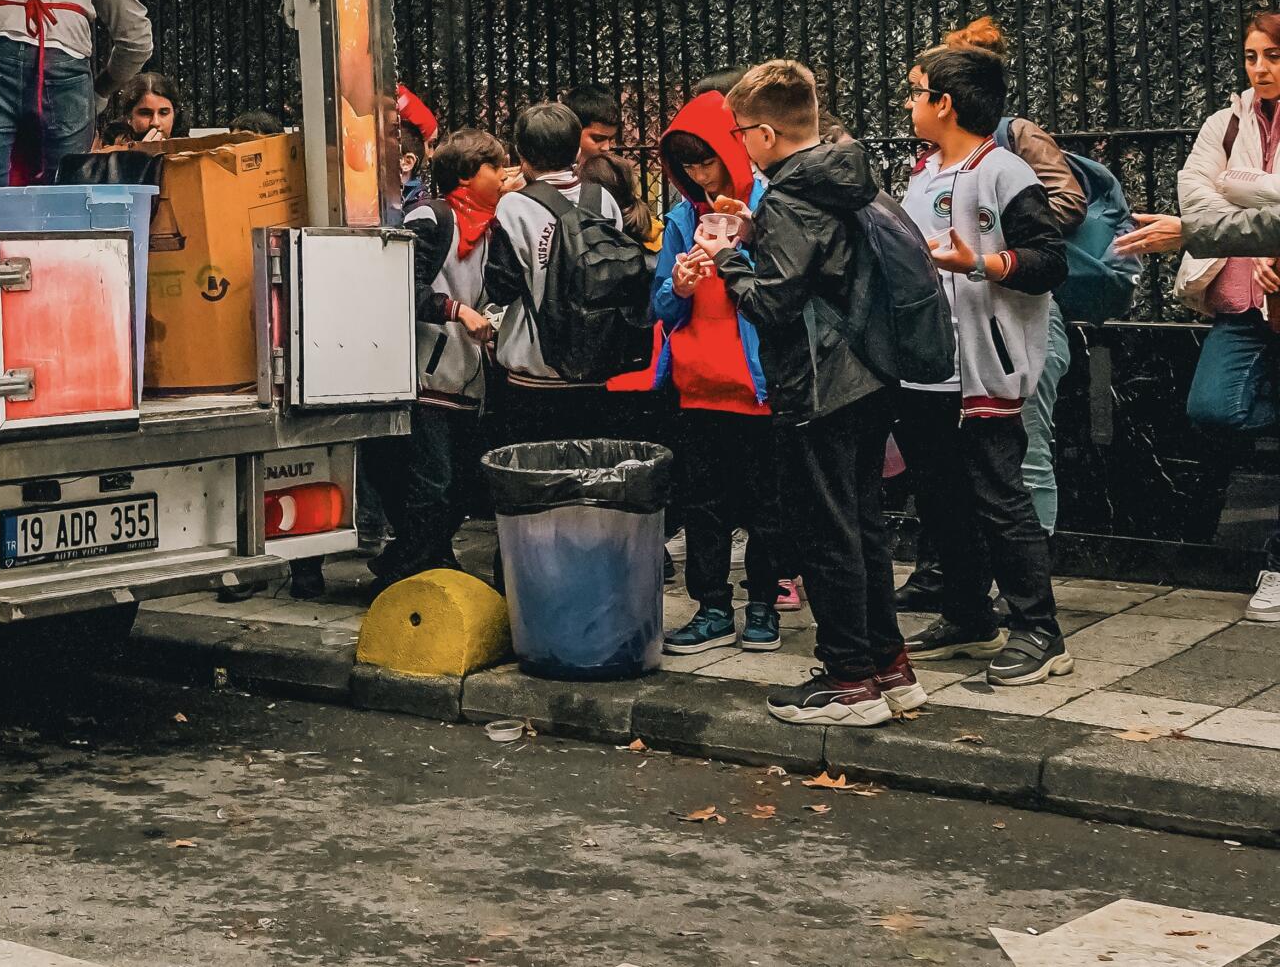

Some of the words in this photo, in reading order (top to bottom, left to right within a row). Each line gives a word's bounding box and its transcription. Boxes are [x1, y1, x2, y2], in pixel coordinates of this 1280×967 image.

[20, 516, 44, 554] 19
[55, 510, 98, 550] ADR
[110, 502, 151, 542] 355
[6, 540, 16, 551] TR
